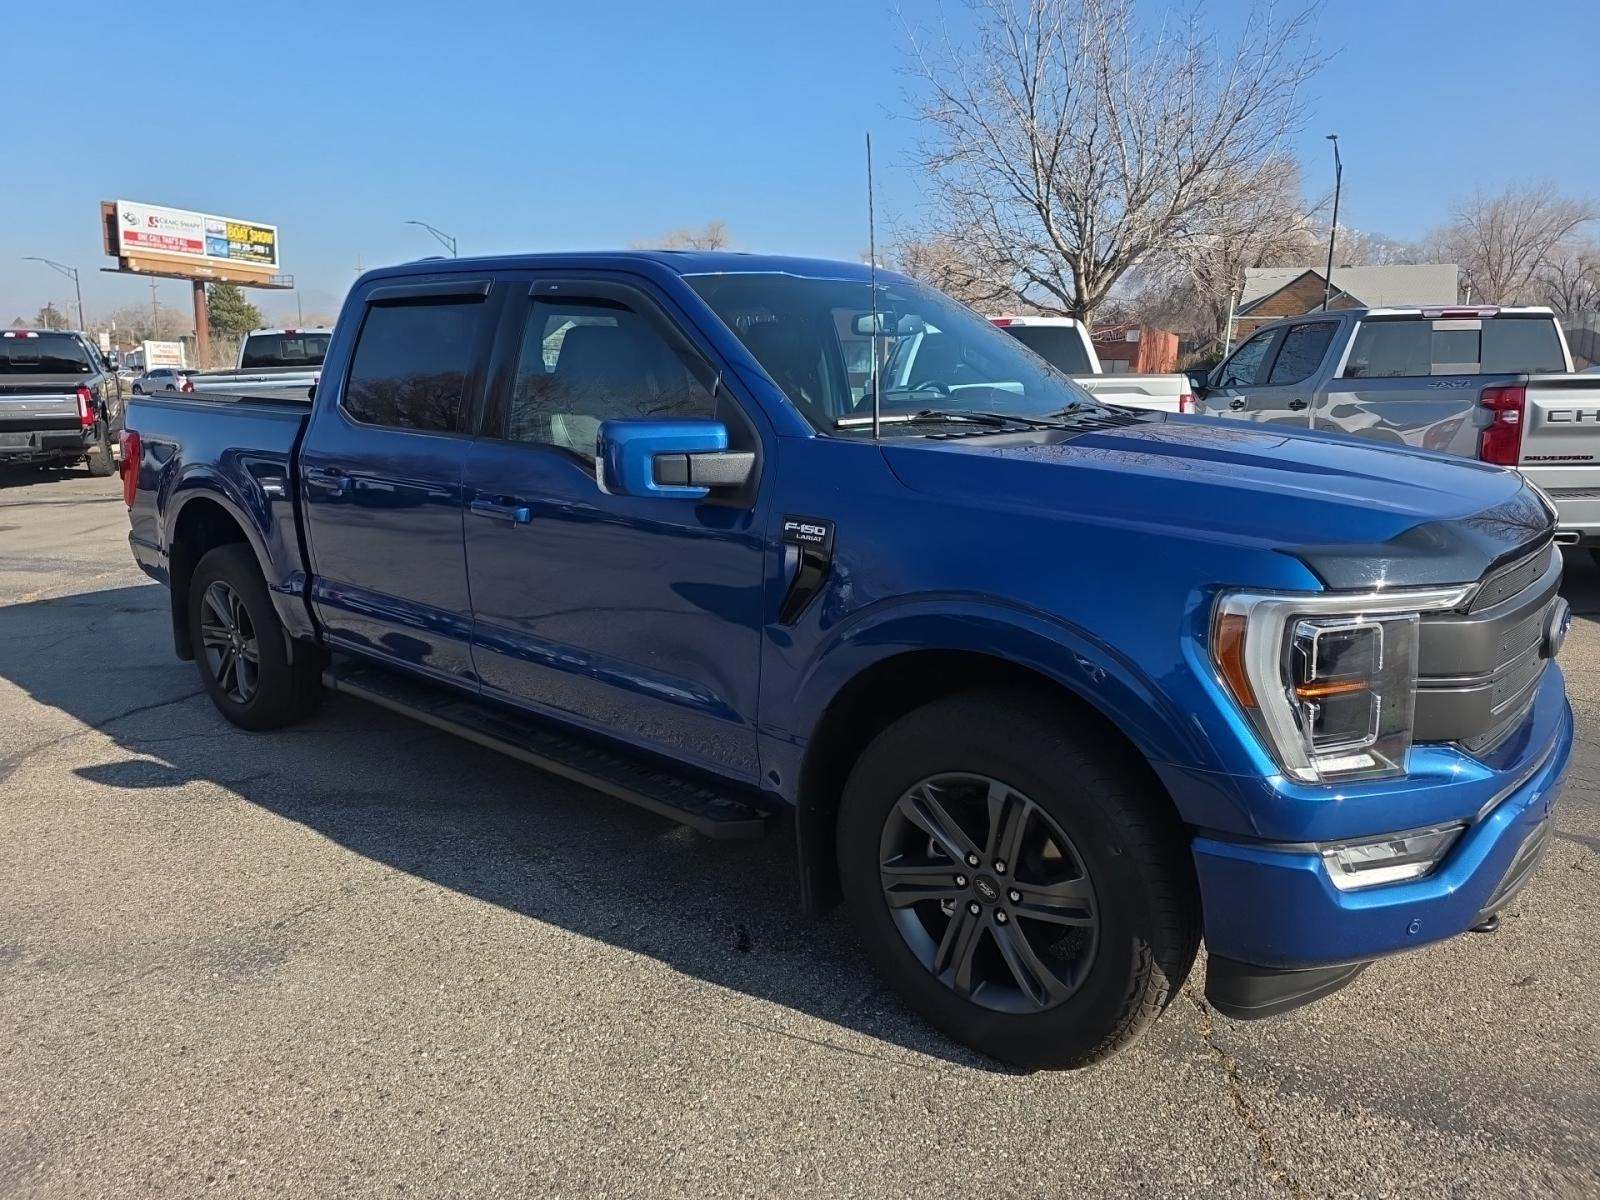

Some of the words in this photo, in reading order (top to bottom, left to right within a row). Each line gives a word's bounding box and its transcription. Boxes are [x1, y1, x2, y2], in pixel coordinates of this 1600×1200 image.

[228, 226, 248, 241] BOAT
[249, 230, 273, 244] SHOW
[1523, 454, 1595, 462] SILVERADO
[785, 521, 826, 536] F-150
[796, 533, 823, 542] LARIAT
